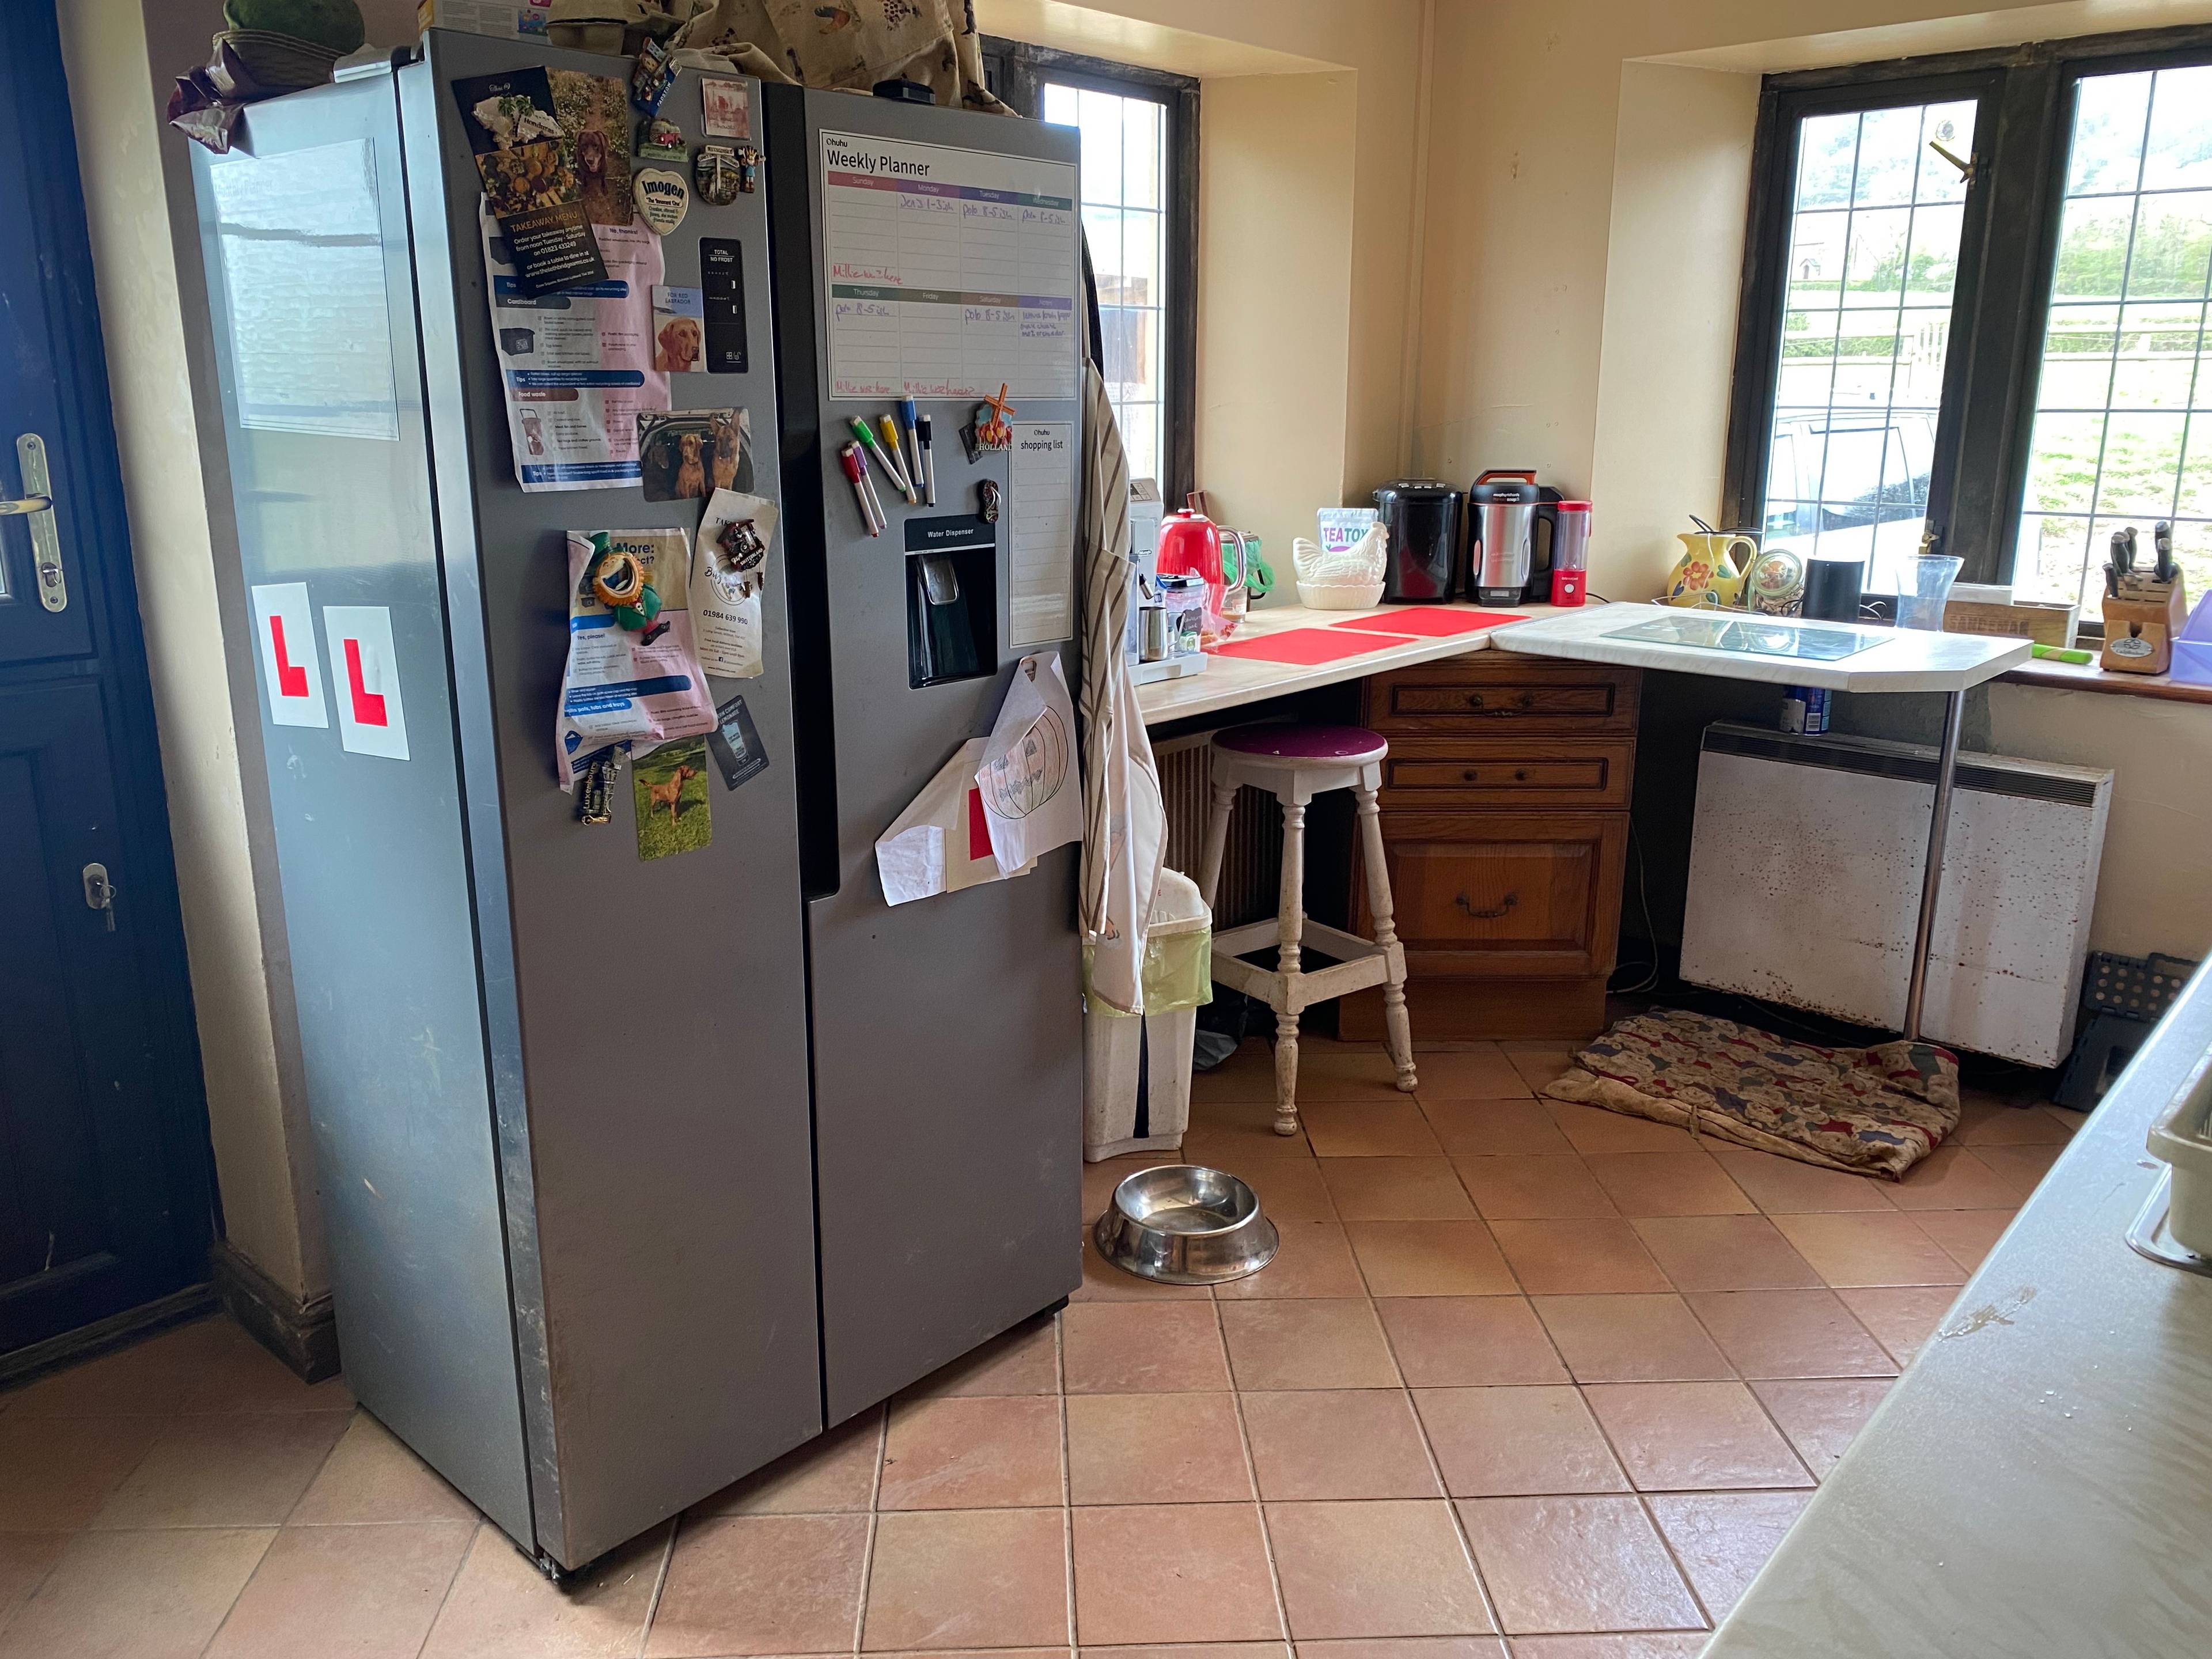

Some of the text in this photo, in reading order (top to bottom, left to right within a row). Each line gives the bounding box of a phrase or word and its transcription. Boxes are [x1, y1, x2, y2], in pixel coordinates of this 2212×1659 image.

[657, 82, 671, 107] PADSTOW
[524, 118, 554, 134] Honduras
[826, 138, 848, 147] Ohuhu
[827, 149, 930, 176] Weekly Planner
[853, 177, 874, 186] Sunday
[642, 181, 684, 200] Imogen
[918, 184, 940, 193] Monday
[979, 190, 999, 199] Tuesday
[510, 211, 577, 233] TAKEAWAY MENU
[541, 229, 565, 238] takeaway
[565, 225, 583, 233] anytime
[543, 237, 563, 245] Tuesday
[566, 232, 586, 240] Saturday
[541, 245, 558, 254] 01823
[558, 241, 576, 249] 433249
[533, 260, 546, 268] book
[853, 289, 879, 297] Thursday
[923, 293, 939, 301] Friday
[979, 296, 1001, 304] Saturday
[1021, 440, 1063, 451] shopping list
[945, 529, 974, 537] Dispenser
[616, 542, 654, 554] More:
[703, 609, 748, 625] 01984 639 990
[269, 615, 309, 698] L
[343, 638, 388, 727] L
[583, 762, 598, 809] Luxembourg
